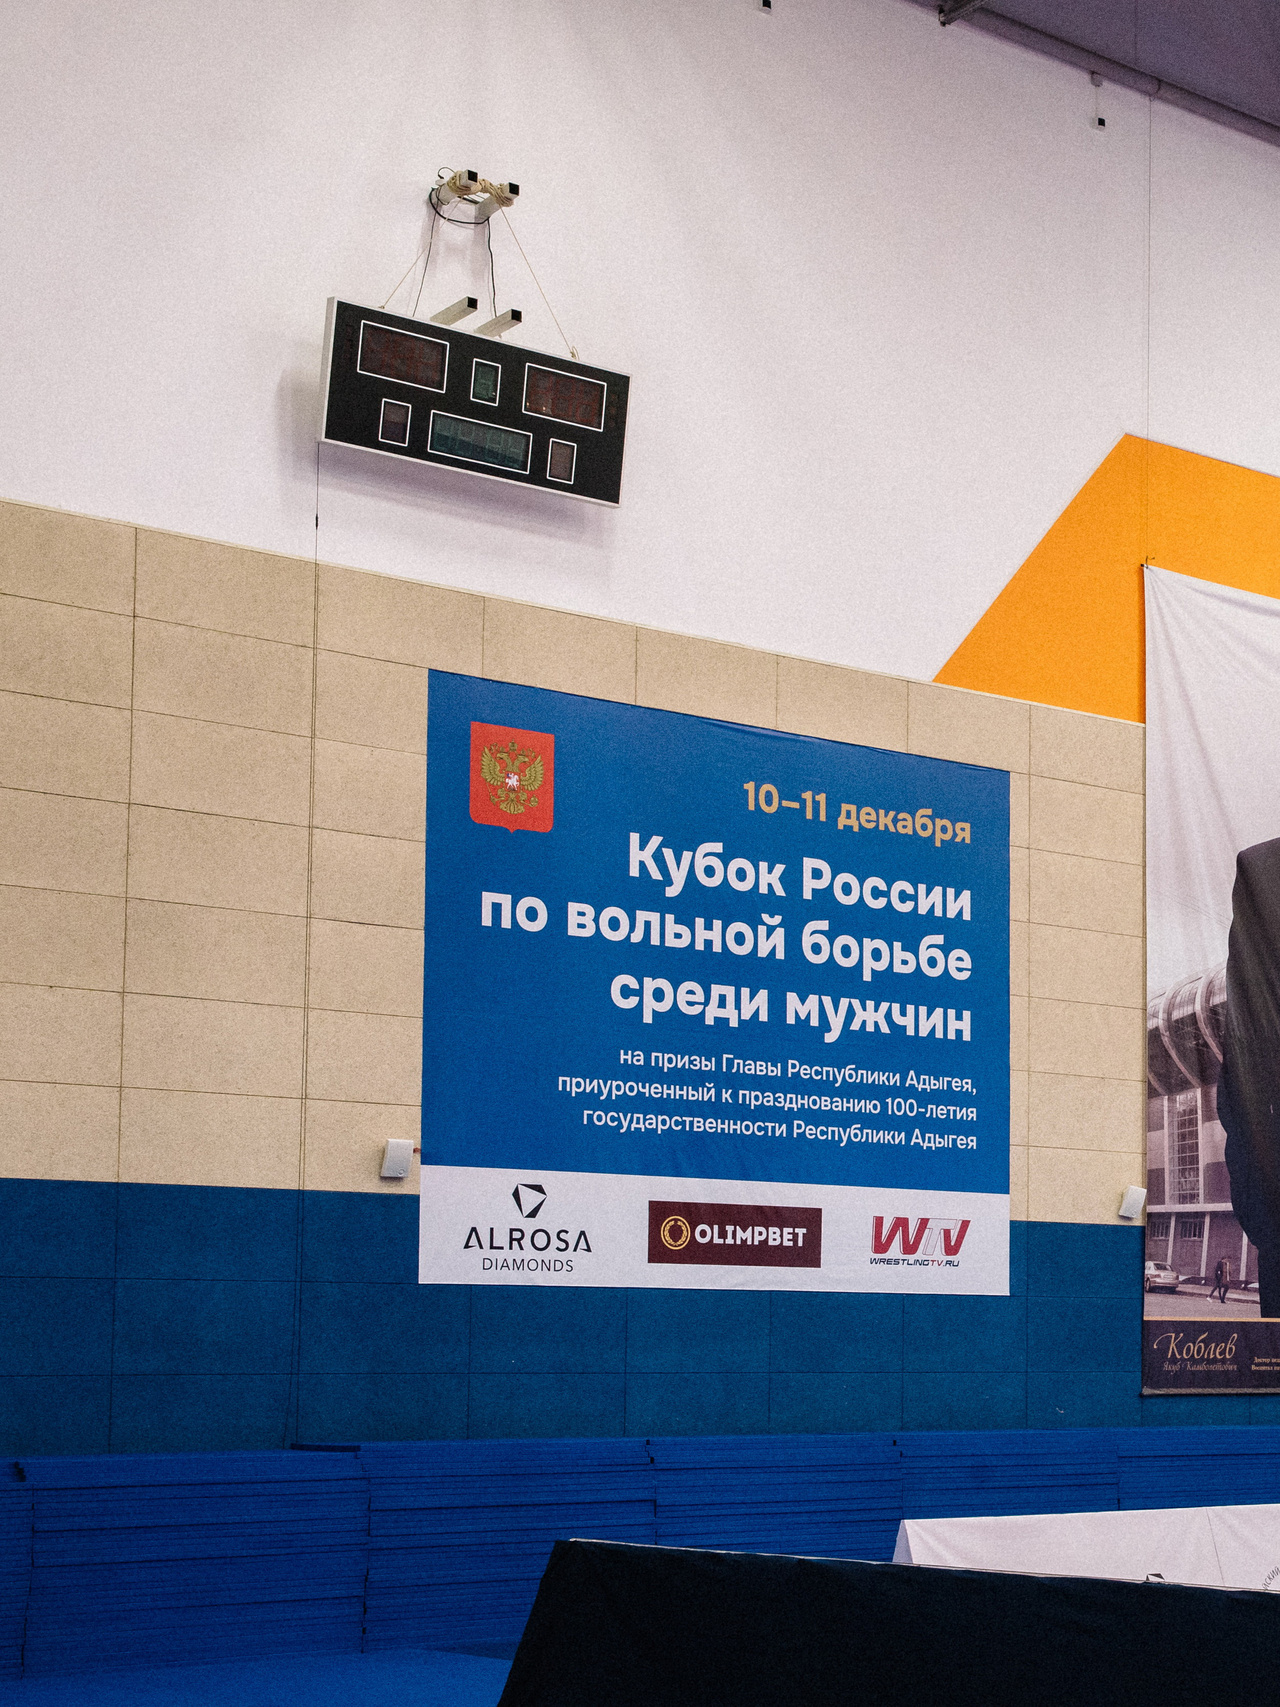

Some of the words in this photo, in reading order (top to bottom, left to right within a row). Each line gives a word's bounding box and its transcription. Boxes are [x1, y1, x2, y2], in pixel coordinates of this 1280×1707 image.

[837, 802, 971, 848] декабря
[629, 831, 787, 898] Кубок
[802, 856, 971, 921] России
[481, 891, 548, 933] по
[567, 901, 785, 960] вольной
[801, 919, 972, 982] борьбе
[610, 974, 769, 1028] среди
[786, 991, 971, 1044] мужчин
[620, 1049, 644, 1066] на
[651, 1052, 716, 1073] призы
[722, 1053, 781, 1077] Главы
[787, 1059, 900, 1088] Республики
[905, 1069, 977, 1096] Адыгея,
[558, 1076, 716, 1102] приуроченный
[721, 1088, 733, 1103] к
[738, 1089, 881, 1114] празднованию
[885, 1097, 977, 1121] 100-летия
[583, 1110, 787, 1138] государственности
[793, 1119, 906, 1147] Республики
[910, 1128, 977, 1151] Адыгея
[463, 1226, 593, 1253] ALROSA
[694, 1223, 807, 1247] OLIMPBET
[482, 1257, 574, 1273] DIAMONDS
[869, 1257, 960, 1268] WRESTLINGTV.RU
[1153, 1331, 1238, 1359] Коблев
